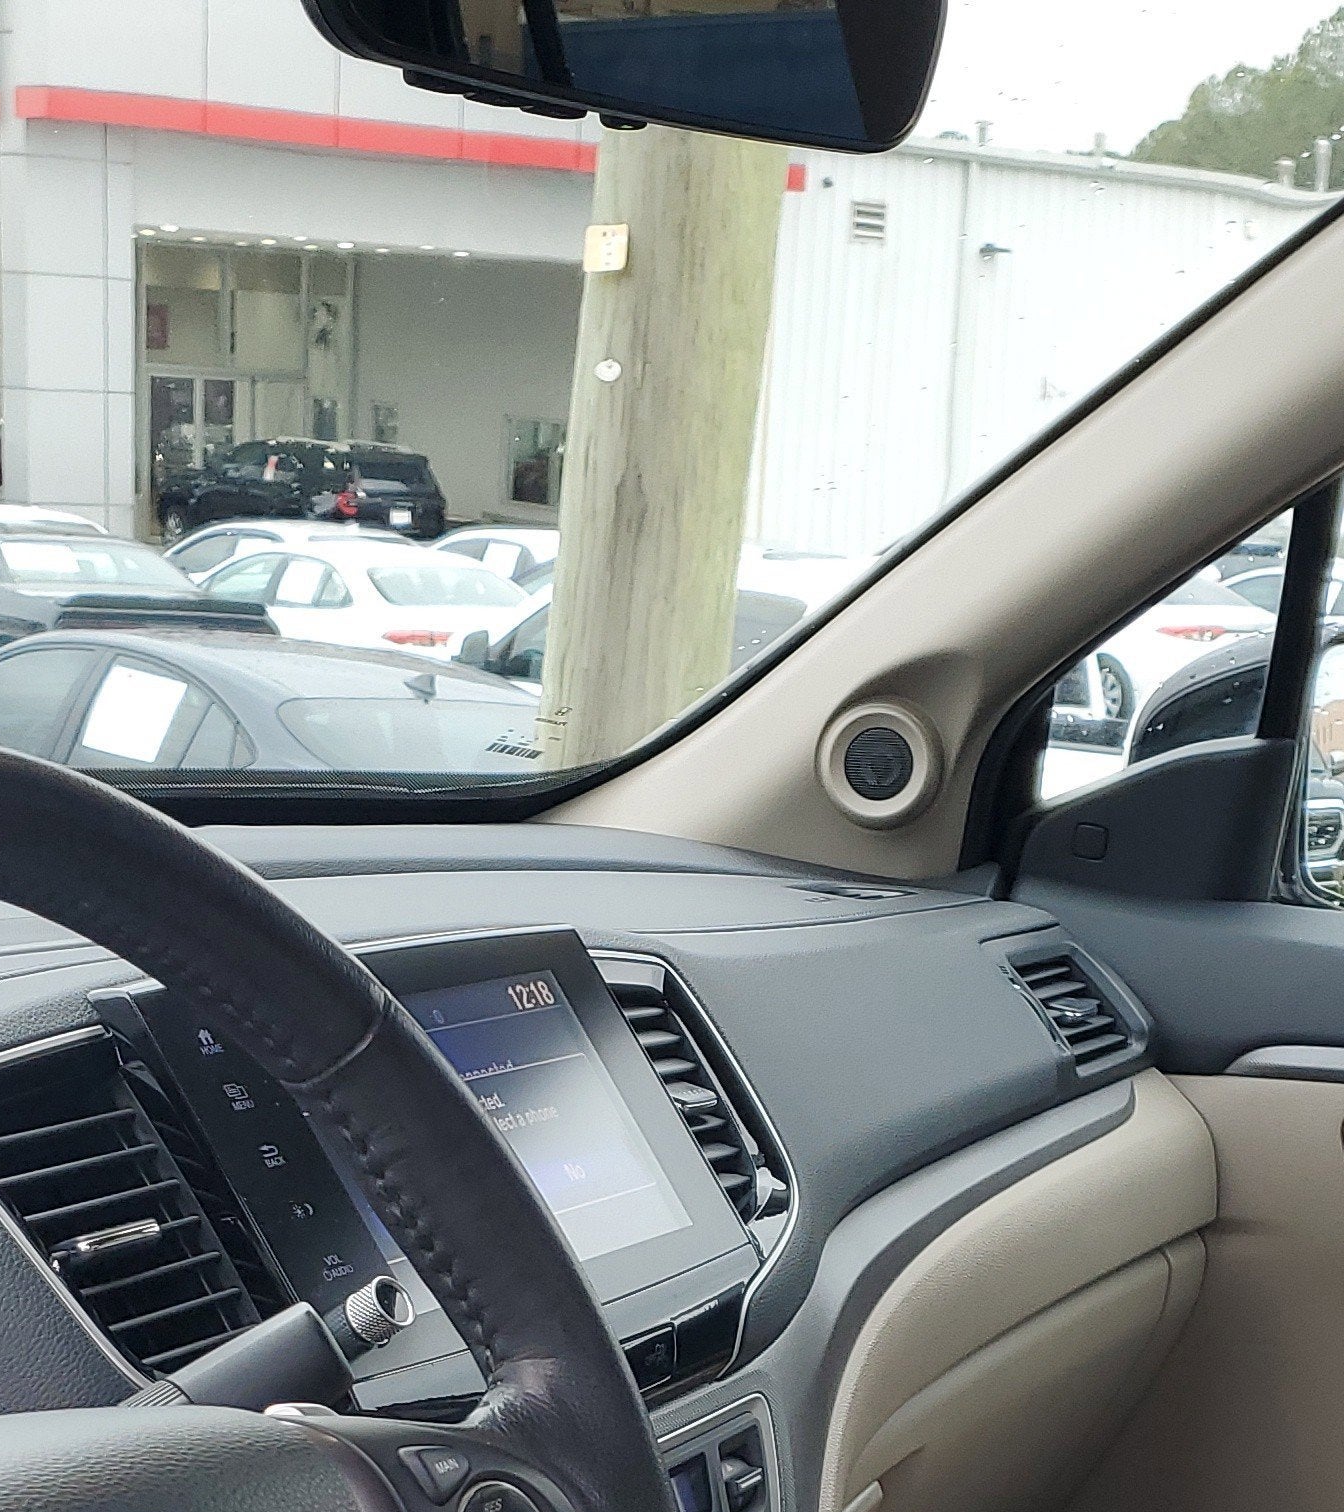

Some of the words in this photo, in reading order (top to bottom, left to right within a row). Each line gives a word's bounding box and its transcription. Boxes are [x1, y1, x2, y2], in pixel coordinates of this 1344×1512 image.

[507, 979, 555, 1011] 12:18
[199, 1043, 225, 1057] HOME
[230, 1099, 255, 1112] MENU
[527, 1105, 559, 1127] phone
[563, 1162, 586, 1181] No
[323, 1254, 343, 1266] VOL
[435, 1458, 459, 1475] MAIN
